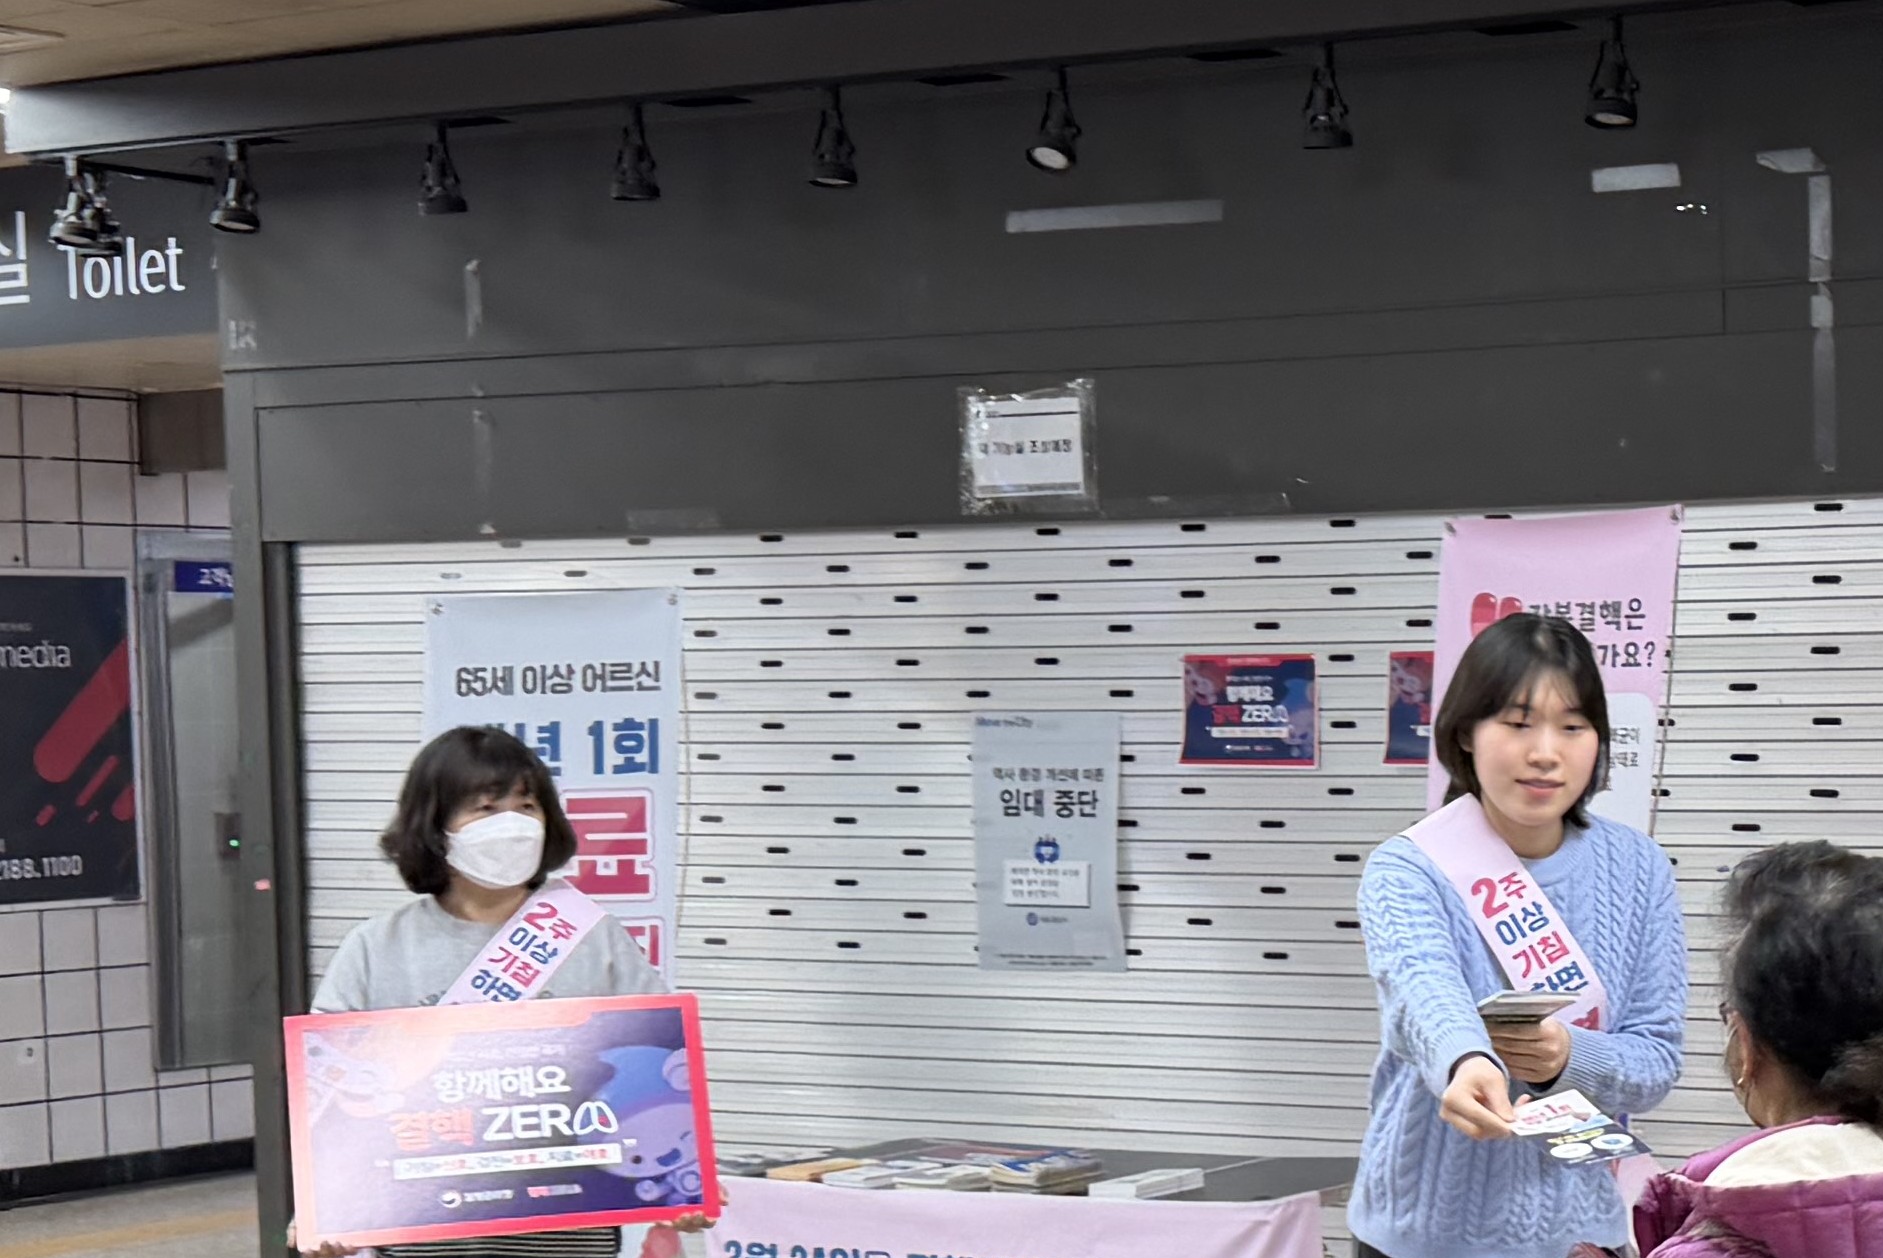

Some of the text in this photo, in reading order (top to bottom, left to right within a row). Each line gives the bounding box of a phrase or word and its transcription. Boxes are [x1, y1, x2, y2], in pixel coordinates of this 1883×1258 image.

[57, 236, 186, 300] Toilet
[1597, 641, 1656, 668] 가요?
[455, 660, 662, 697] 65세 이상 어르신
[587, 717, 659, 776] 1회
[1000, 788, 1099, 819] 임대 중단
[563, 796, 651, 896] 료
[1471, 872, 1527, 919] 2주
[523, 902, 578, 940] 2주
[1495, 901, 1549, 946] 이상
[509, 927, 558, 964] 이상
[1512, 931, 1570, 979] 기침
[488, 946, 541, 988] 기침
[432, 1065, 571, 1104] 함께해요
